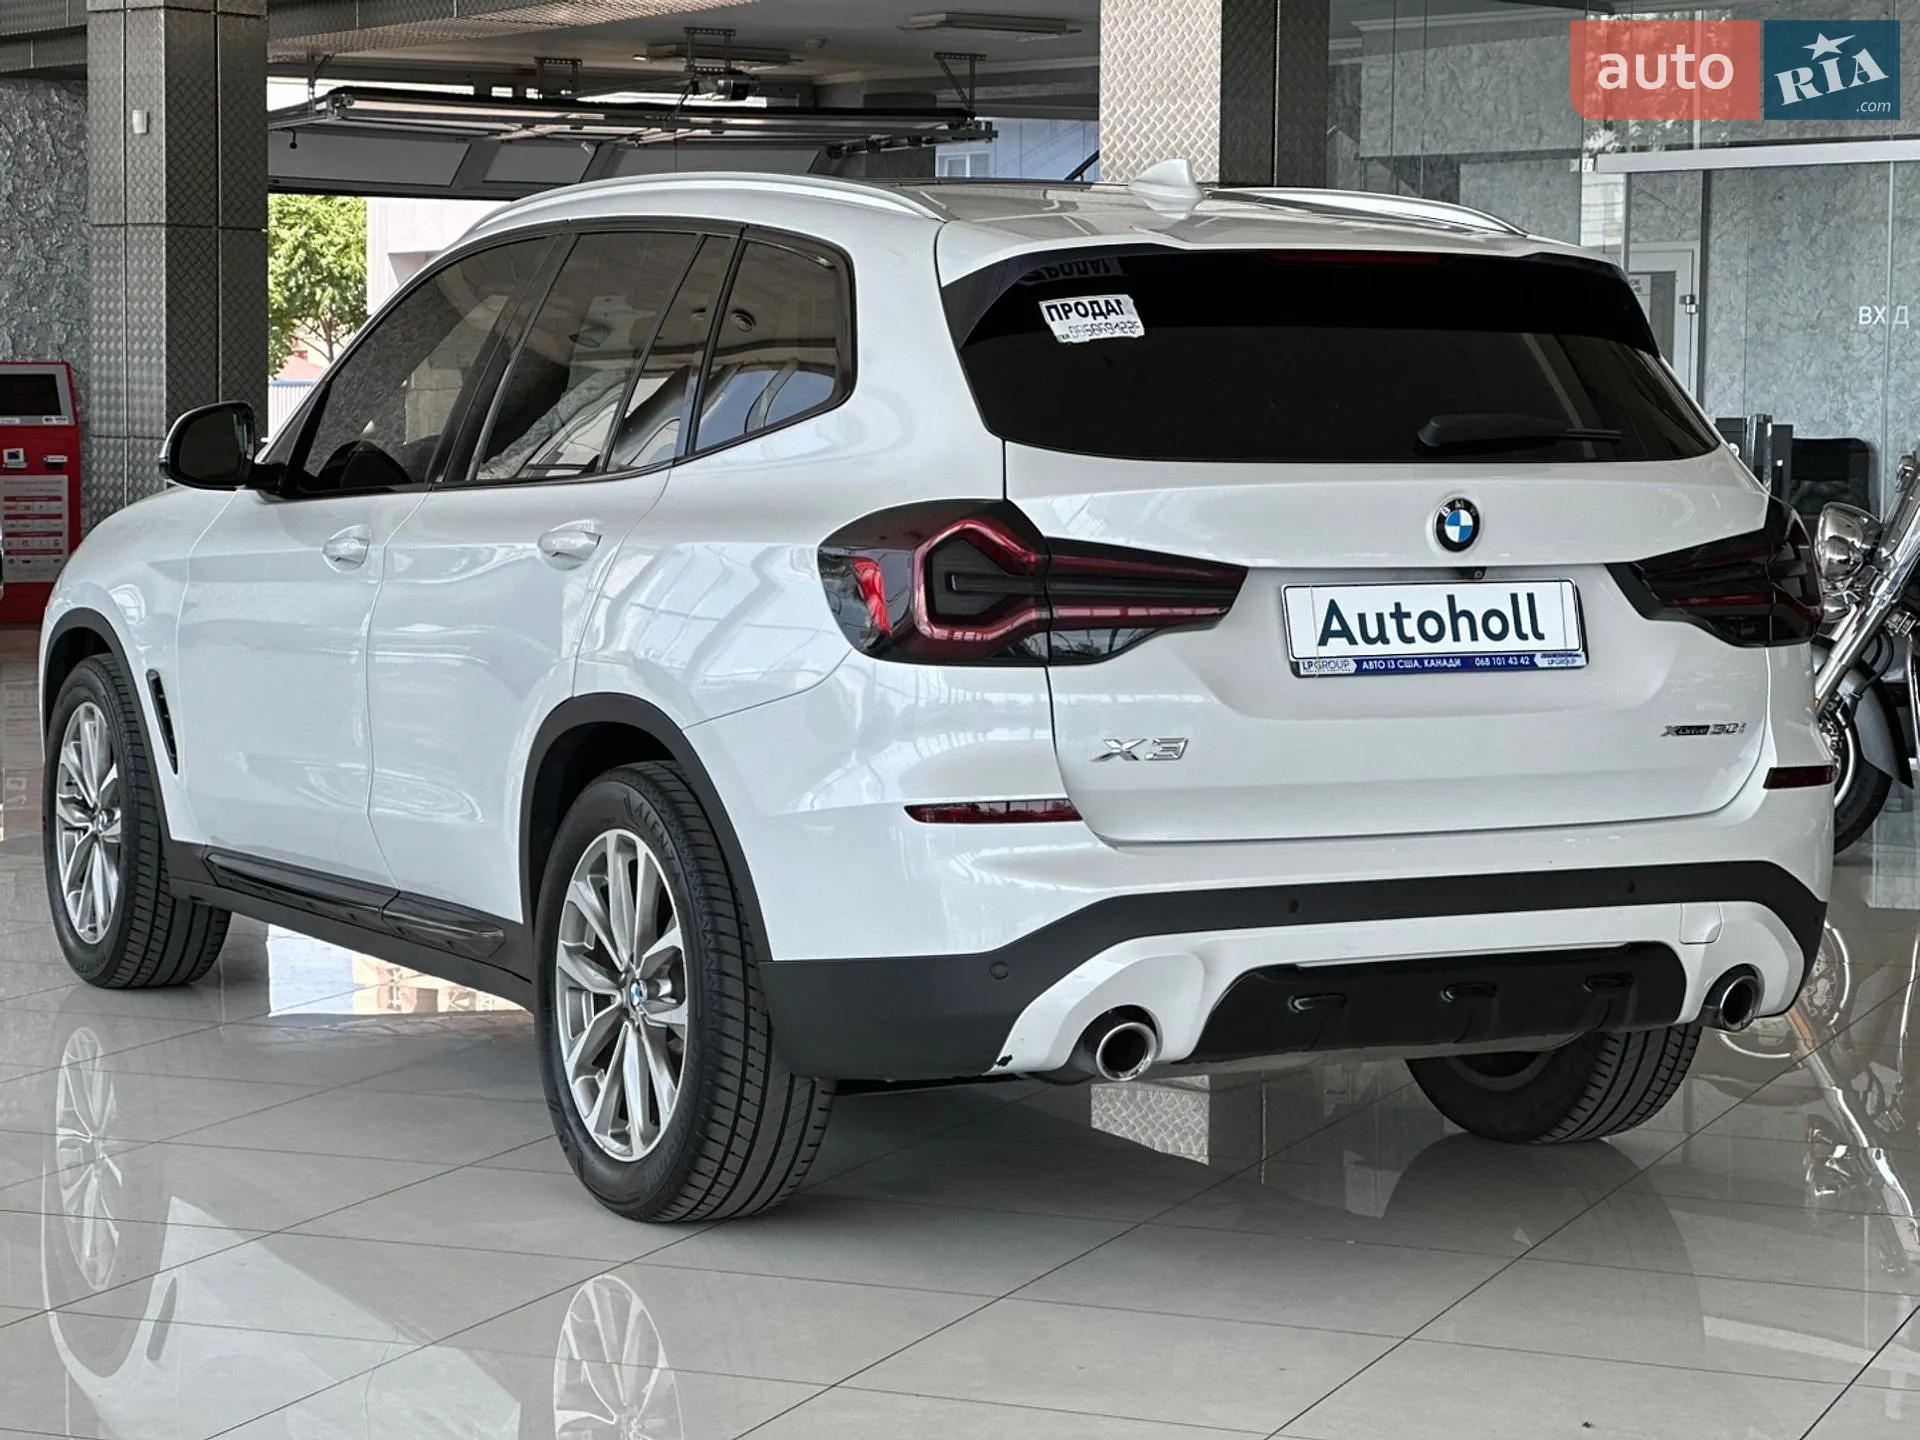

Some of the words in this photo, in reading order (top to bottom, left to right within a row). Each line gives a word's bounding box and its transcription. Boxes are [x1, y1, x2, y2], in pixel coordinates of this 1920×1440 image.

[1045, 299, 1125, 321] ПРОДА
[1859, 305, 1909, 329] ВХД
[1317, 592, 1545, 647] Autoholl
[1362, 660, 1386, 670] АВТО
[1424, 658, 1461, 669] КАНАДИ
[1475, 657, 1491, 667] 068
[1492, 656, 1506, 666] 101
[1508, 656, 1519, 665] 43
[1520, 655, 1530, 665] 42
[1089, 737, 1189, 762] X3
